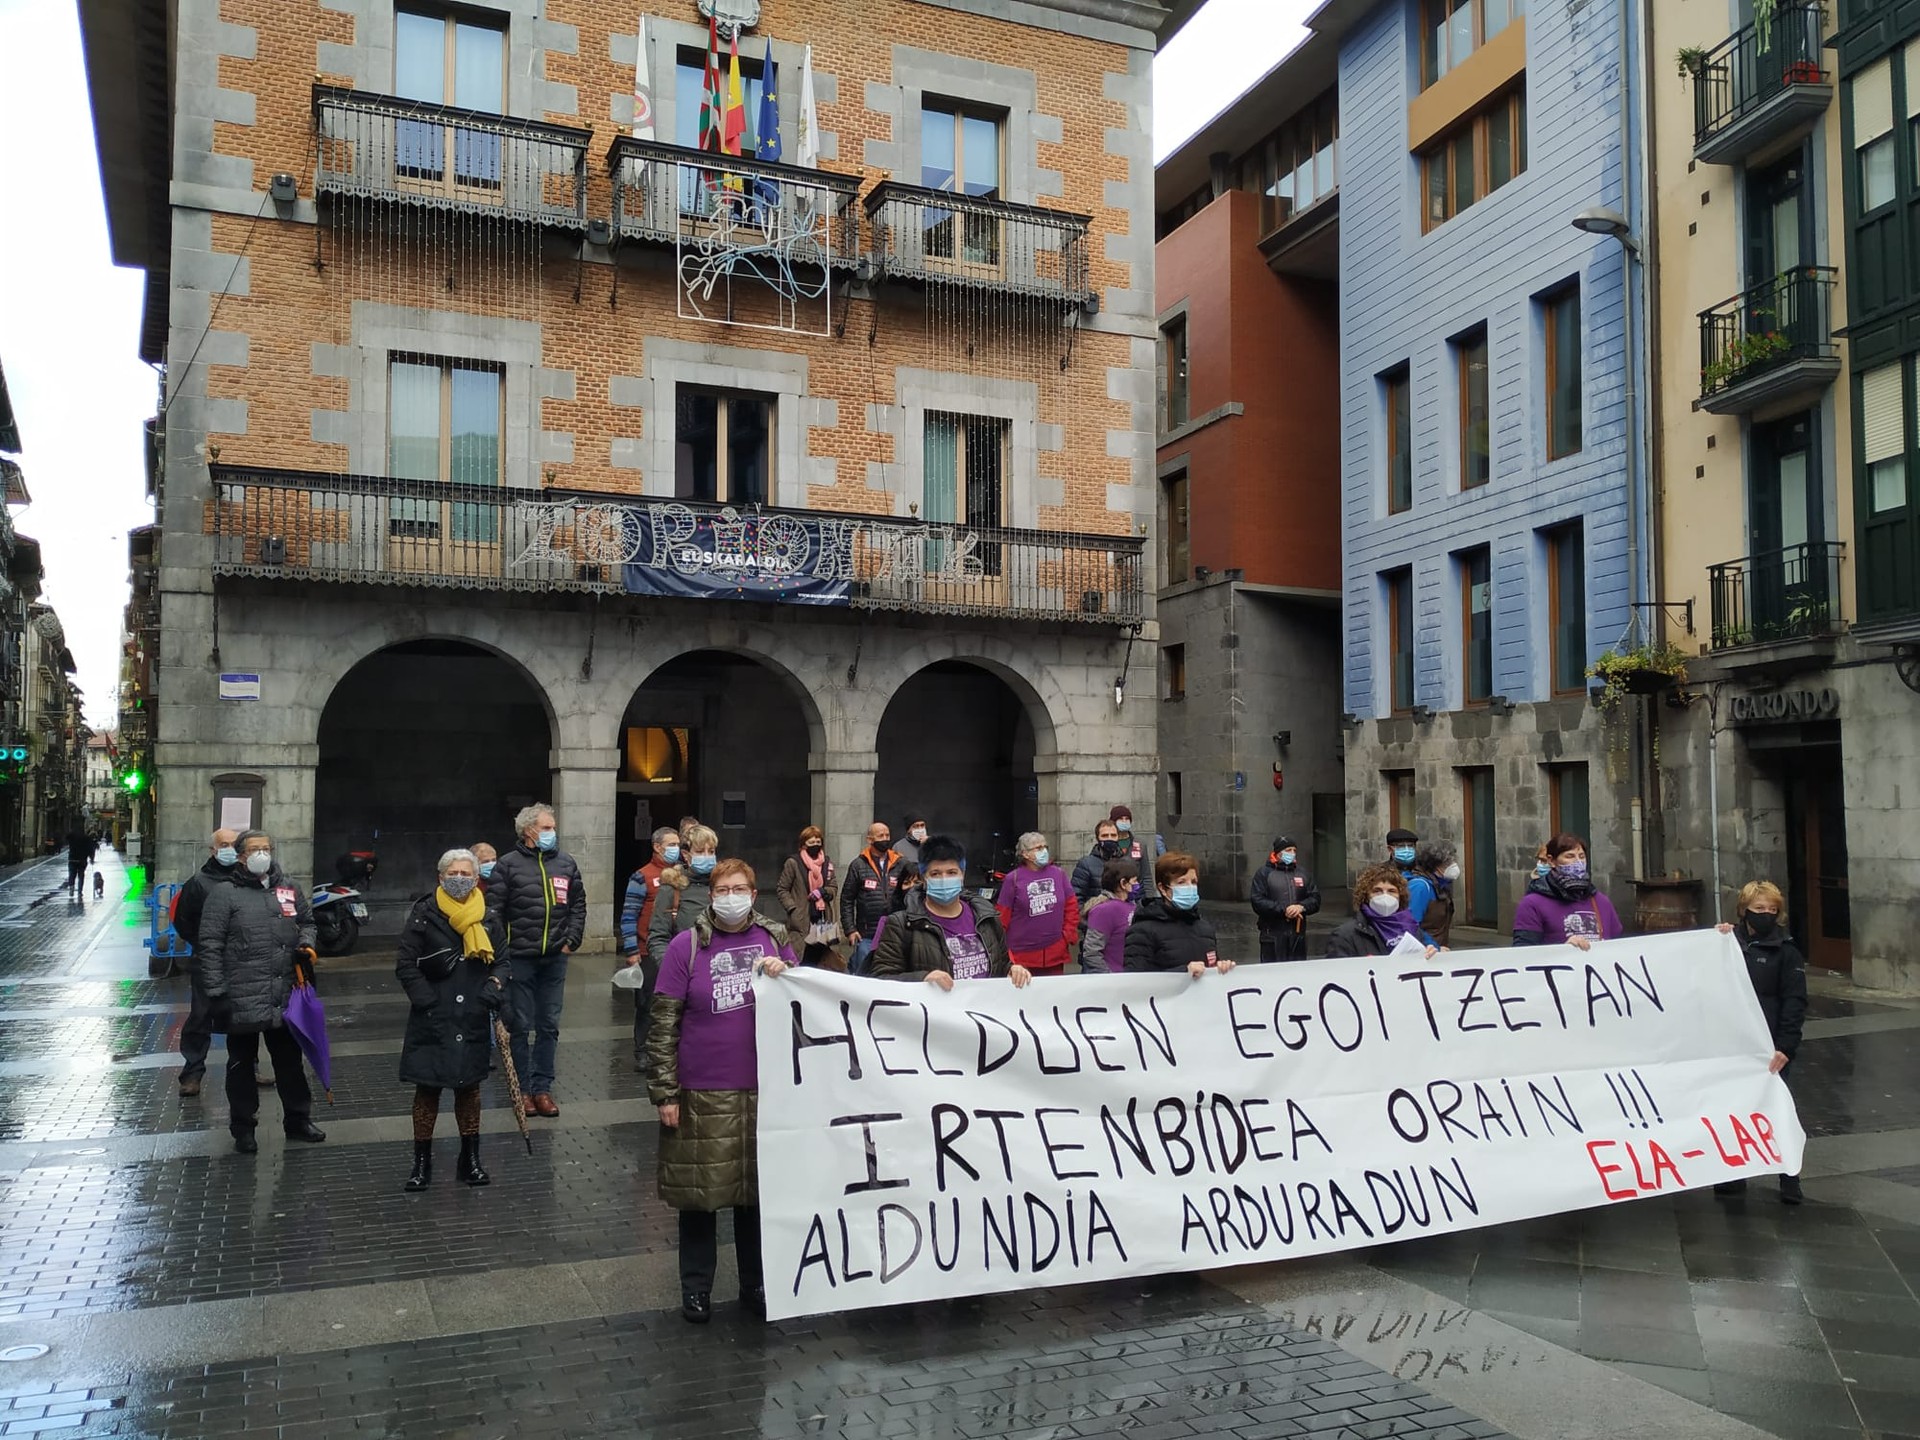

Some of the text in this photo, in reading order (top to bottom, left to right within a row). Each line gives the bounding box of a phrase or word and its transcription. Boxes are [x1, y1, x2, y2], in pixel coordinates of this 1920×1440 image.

[1733, 688, 1839, 720] GARONDO
[790, 997, 1177, 1086] HELDUEN
[1181, 1157, 1479, 1257] ARDURADUN
